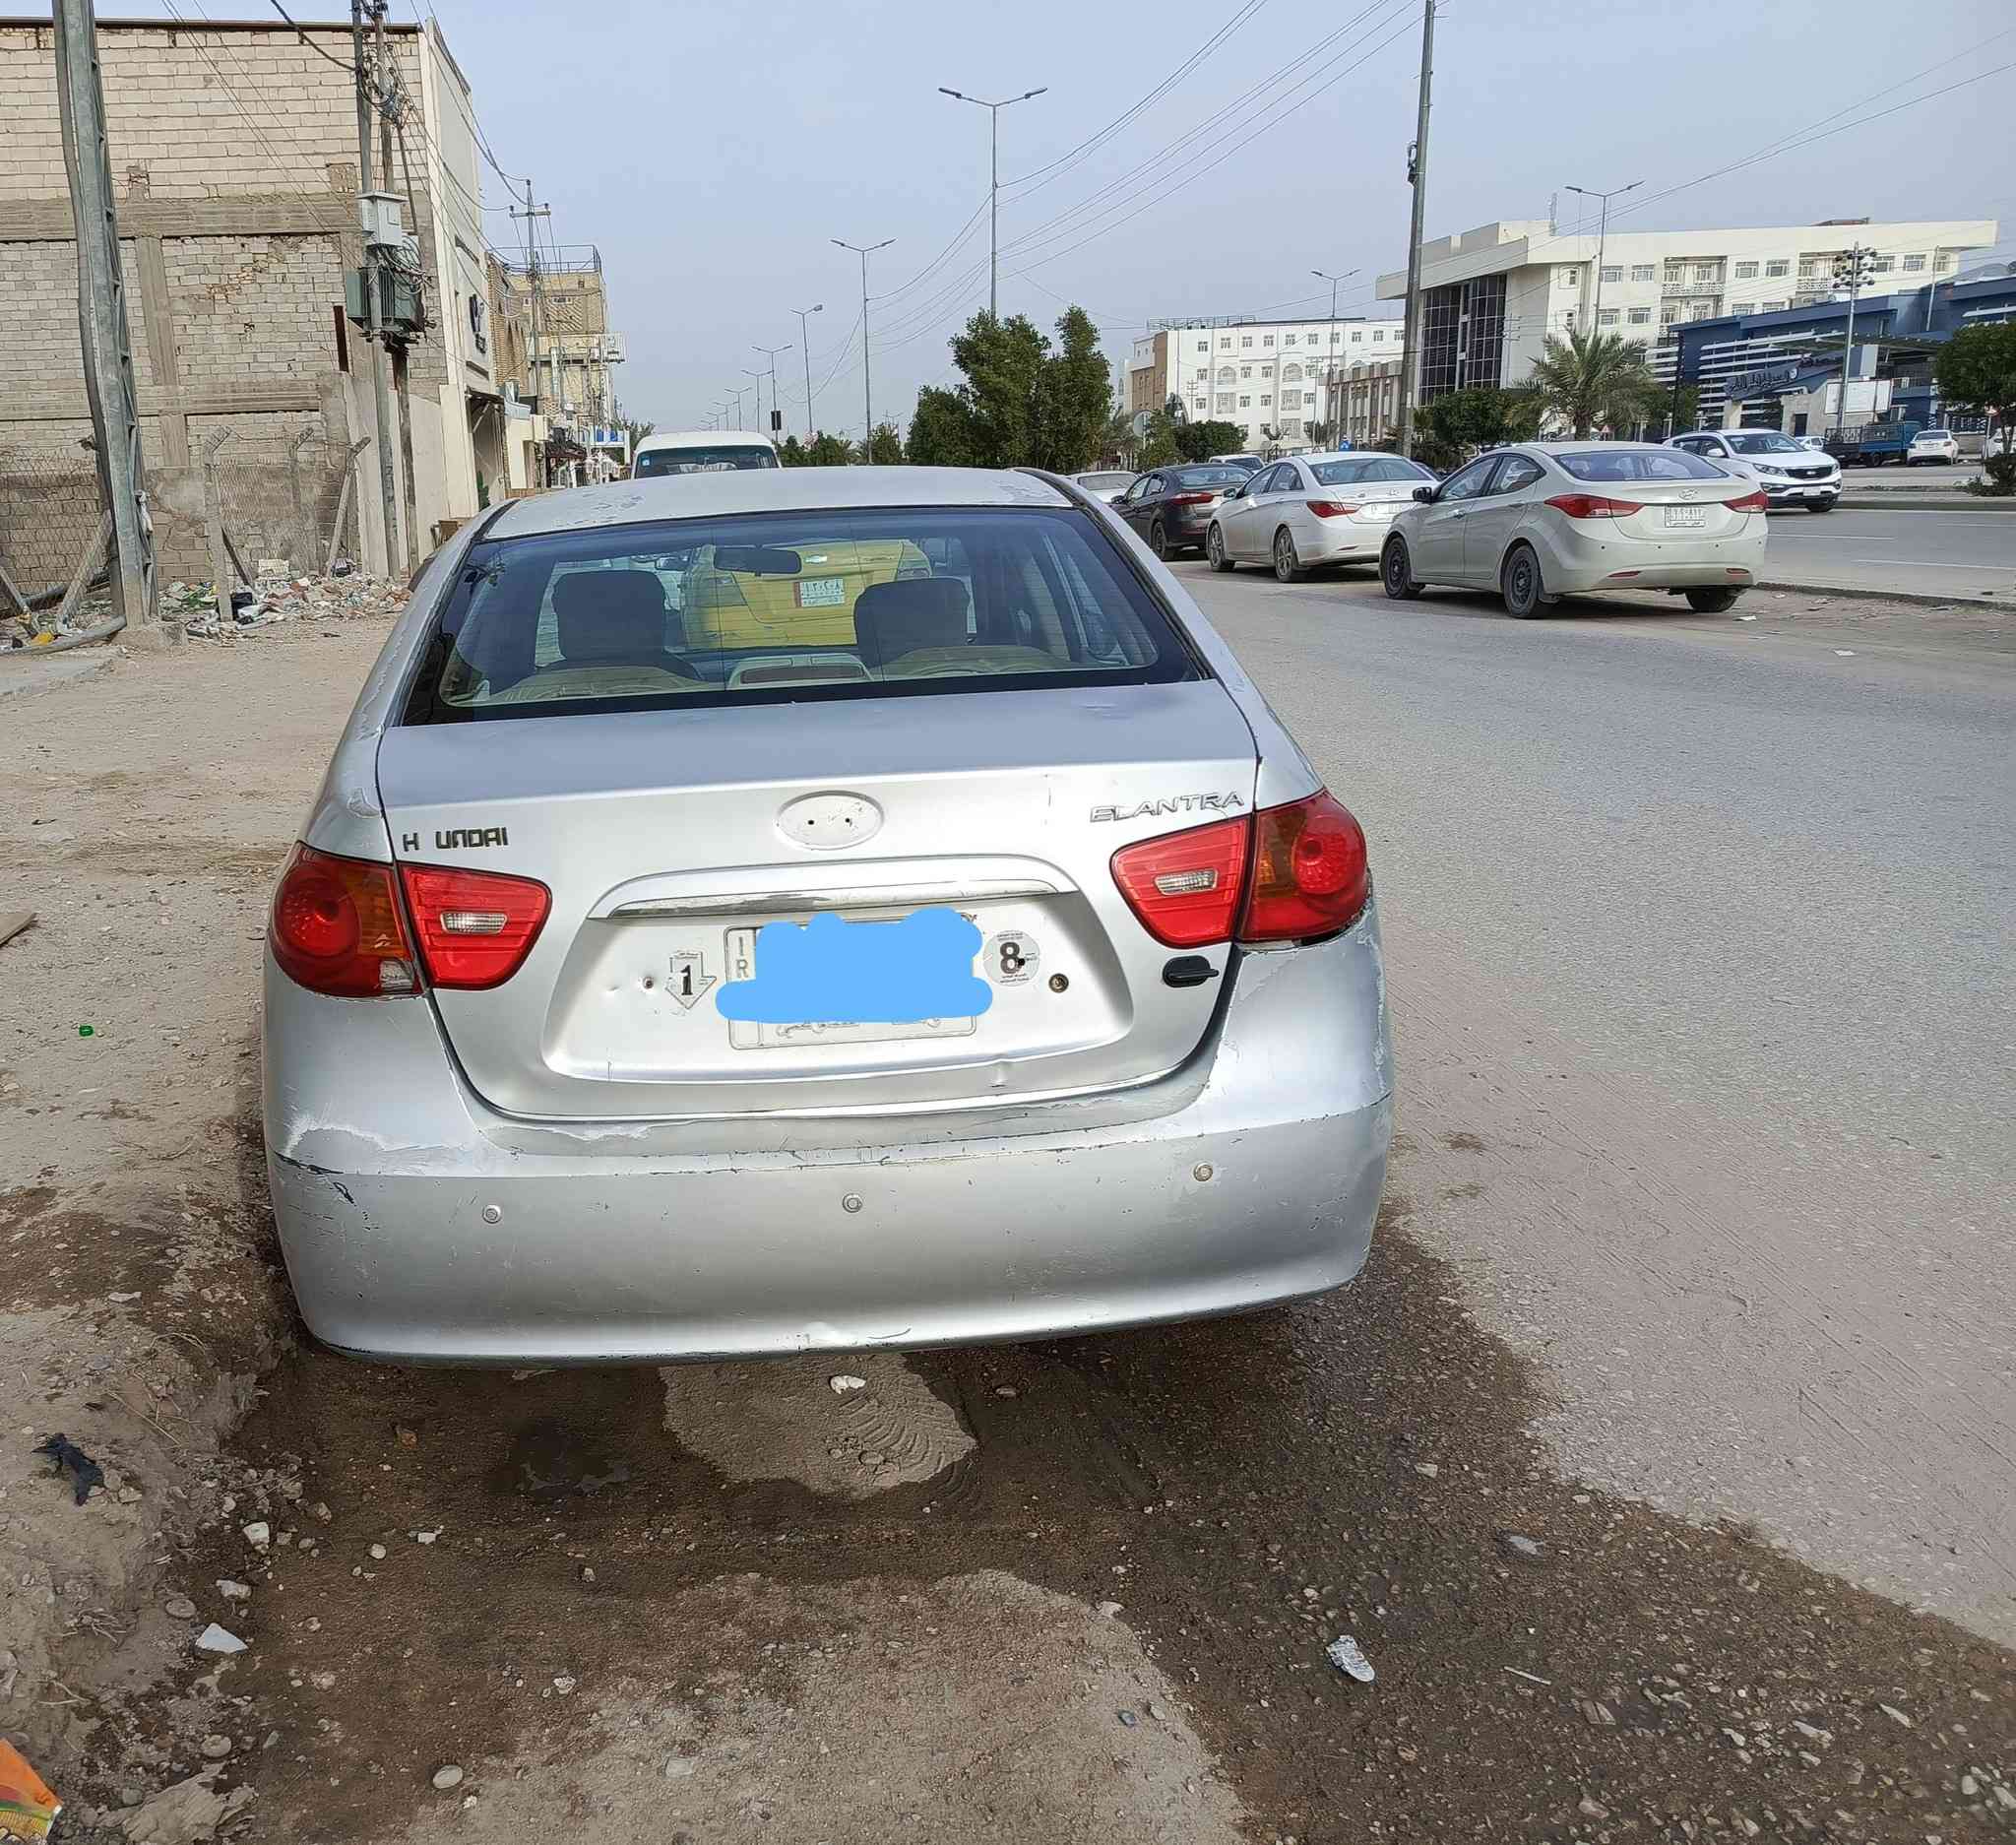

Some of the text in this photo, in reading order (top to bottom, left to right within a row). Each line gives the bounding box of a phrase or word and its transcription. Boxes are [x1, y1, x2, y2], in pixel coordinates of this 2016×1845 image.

[1090, 791, 1244, 822] ELANTRA
[999, 941, 1023, 975] 8
[680, 964, 694, 996] 1
